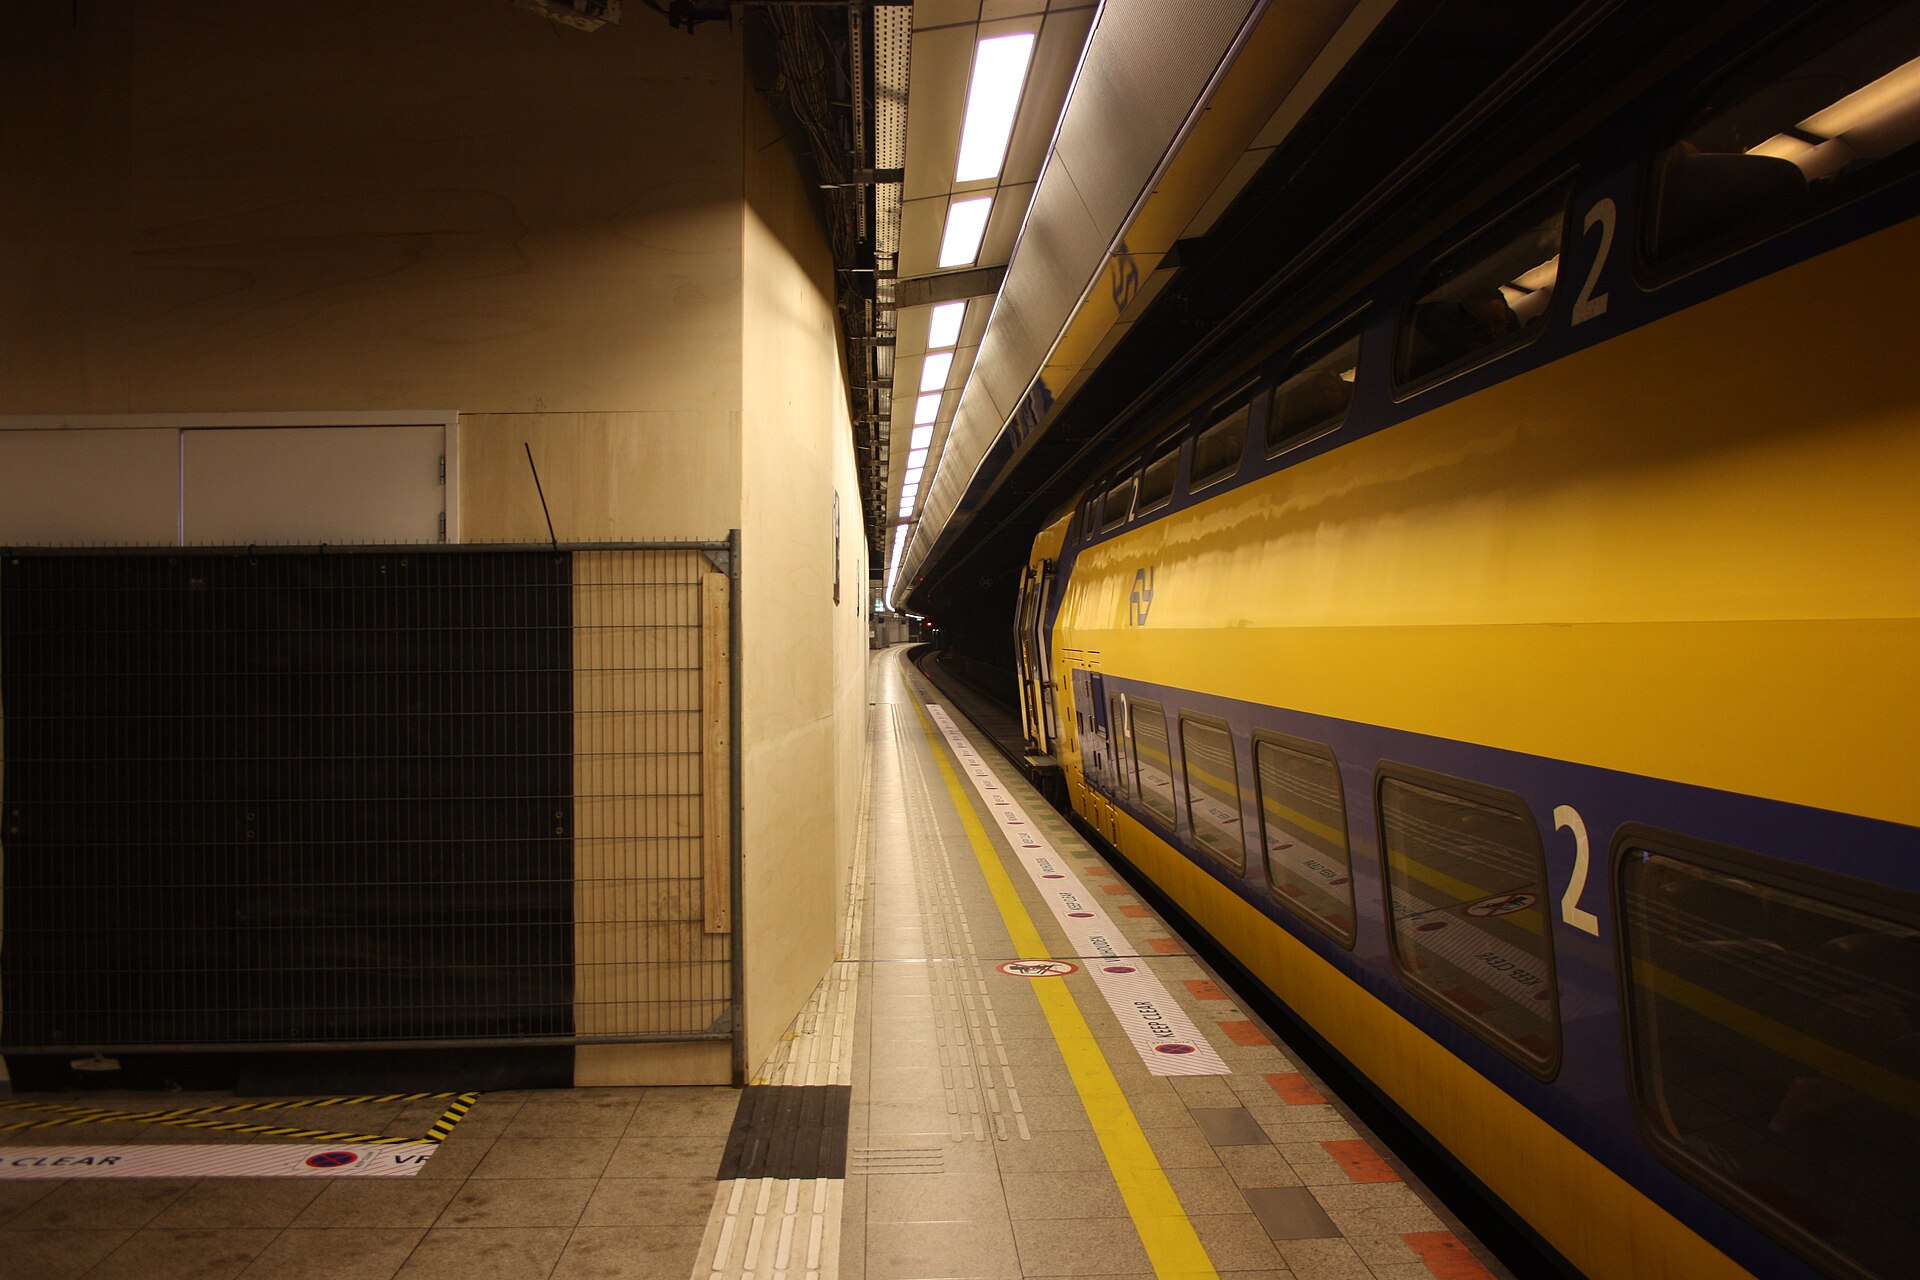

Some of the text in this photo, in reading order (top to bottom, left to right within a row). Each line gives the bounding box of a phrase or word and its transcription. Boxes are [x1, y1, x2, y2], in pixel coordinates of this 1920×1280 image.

[1570, 196, 1617, 328] 2
[1128, 478, 1138, 522] 2
[1120, 693, 1130, 738] 2
[1553, 804, 1600, 937] 2
[1134, 1001, 1162, 1020] CLEAR
[1148, 1021, 1175, 1038] KEEP
[11, 1156, 122, 1166] CLEAR
